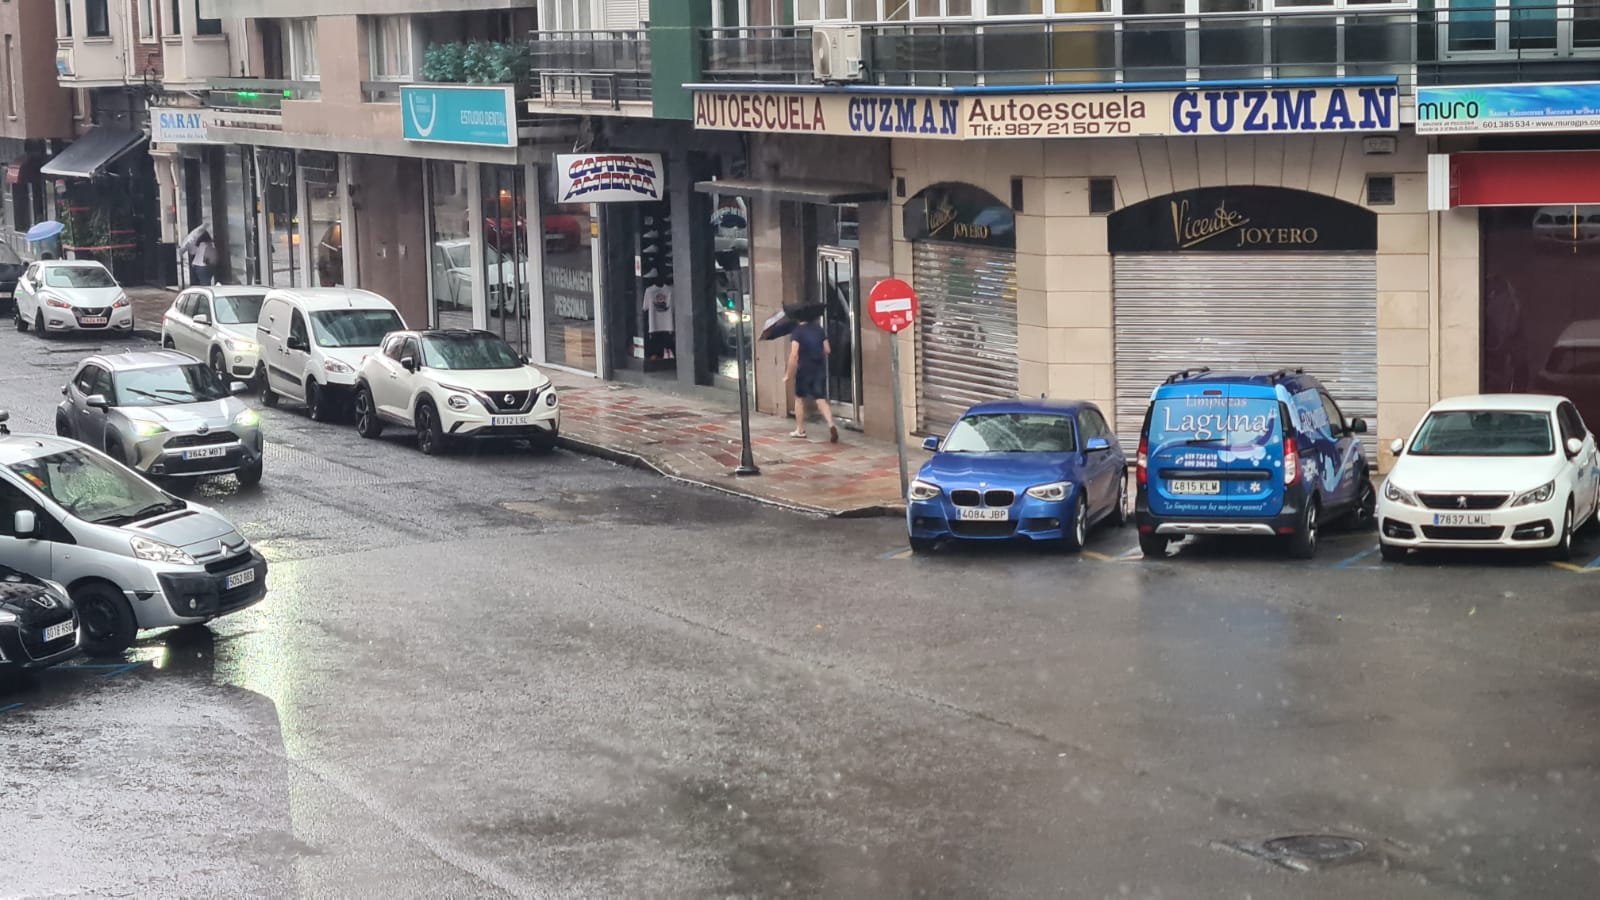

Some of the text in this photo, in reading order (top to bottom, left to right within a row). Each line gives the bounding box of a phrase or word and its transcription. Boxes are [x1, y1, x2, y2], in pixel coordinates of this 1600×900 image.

[697, 94, 960, 135] AUTOESCUELA GUZMAN
[968, 95, 1146, 122] Autoescuela
[1172, 88, 1397, 133] GUZMAN
[1417, 101, 1479, 120] muro
[160, 113, 200, 129] SARAY
[460, 110, 506, 127] ESTUDIO DENTAL
[1004, 123, 1043, 136] 987
[563, 172, 658, 200] AMERICA
[952, 223, 989, 239] JOYERO
[1171, 199, 1245, 244] Vicente
[1238, 227, 1318, 248] JOYERO
[554, 295, 589, 320] PERSONAL
[1186, 393, 1248, 409] Limpiezas
[1163, 406, 1269, 441] Laguna
[1174, 480, 1218, 492] 4815 KLM
[962, 510, 1006, 520] 4084 JBP
[1440, 514, 1486, 525] 7837 LML
